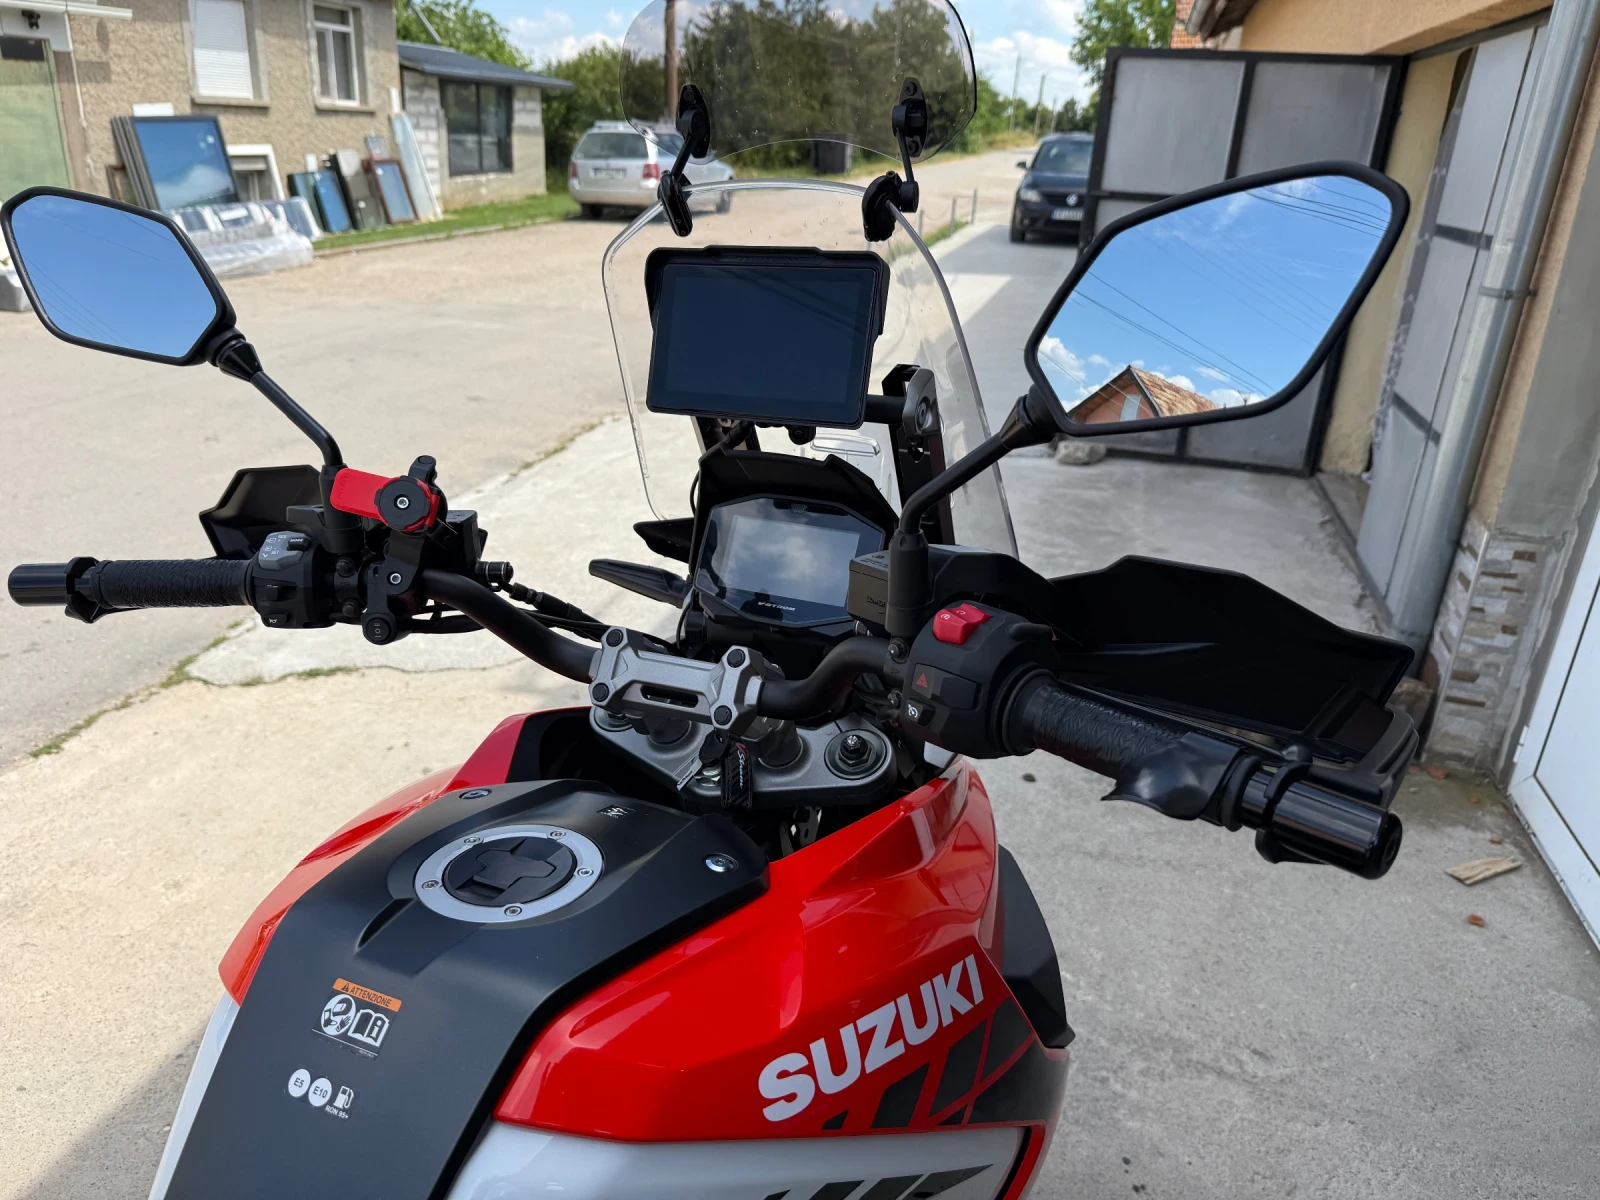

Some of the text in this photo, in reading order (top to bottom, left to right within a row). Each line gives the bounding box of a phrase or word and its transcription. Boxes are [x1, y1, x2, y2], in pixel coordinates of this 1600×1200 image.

[350, 986, 392, 1007] ATTENZIONE
[758, 953, 984, 1122] SUZUKI
[293, 1077, 328, 1098] E5 E10
[325, 1105, 339, 1115] RON
